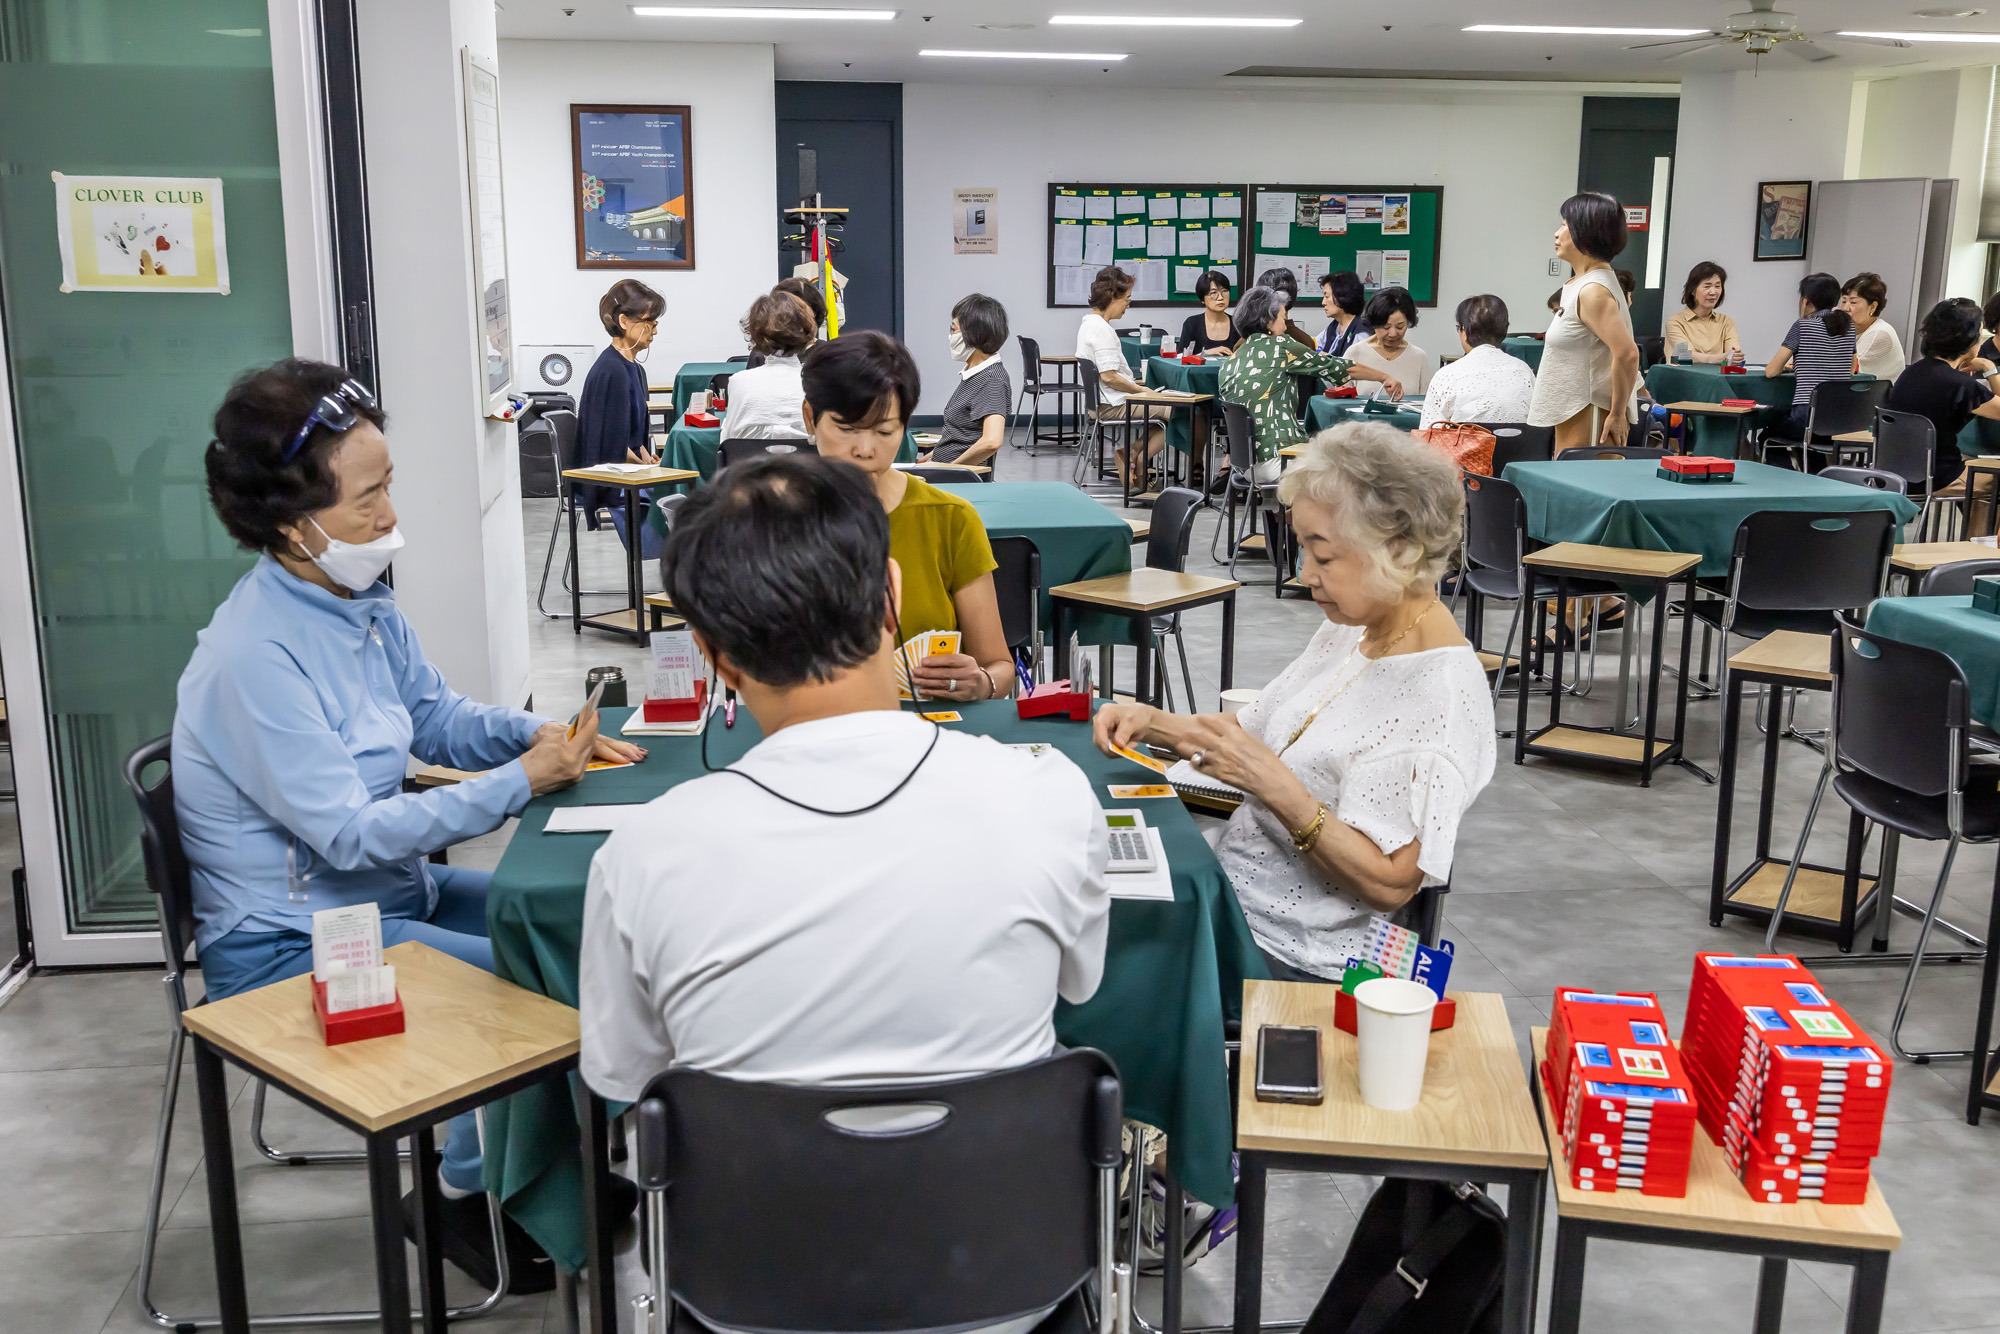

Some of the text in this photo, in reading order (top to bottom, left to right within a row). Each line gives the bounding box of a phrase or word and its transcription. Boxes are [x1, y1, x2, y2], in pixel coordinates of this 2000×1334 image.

[74, 188, 204, 204] CLOVER CLUB
[1443, 943, 1451, 955] A
